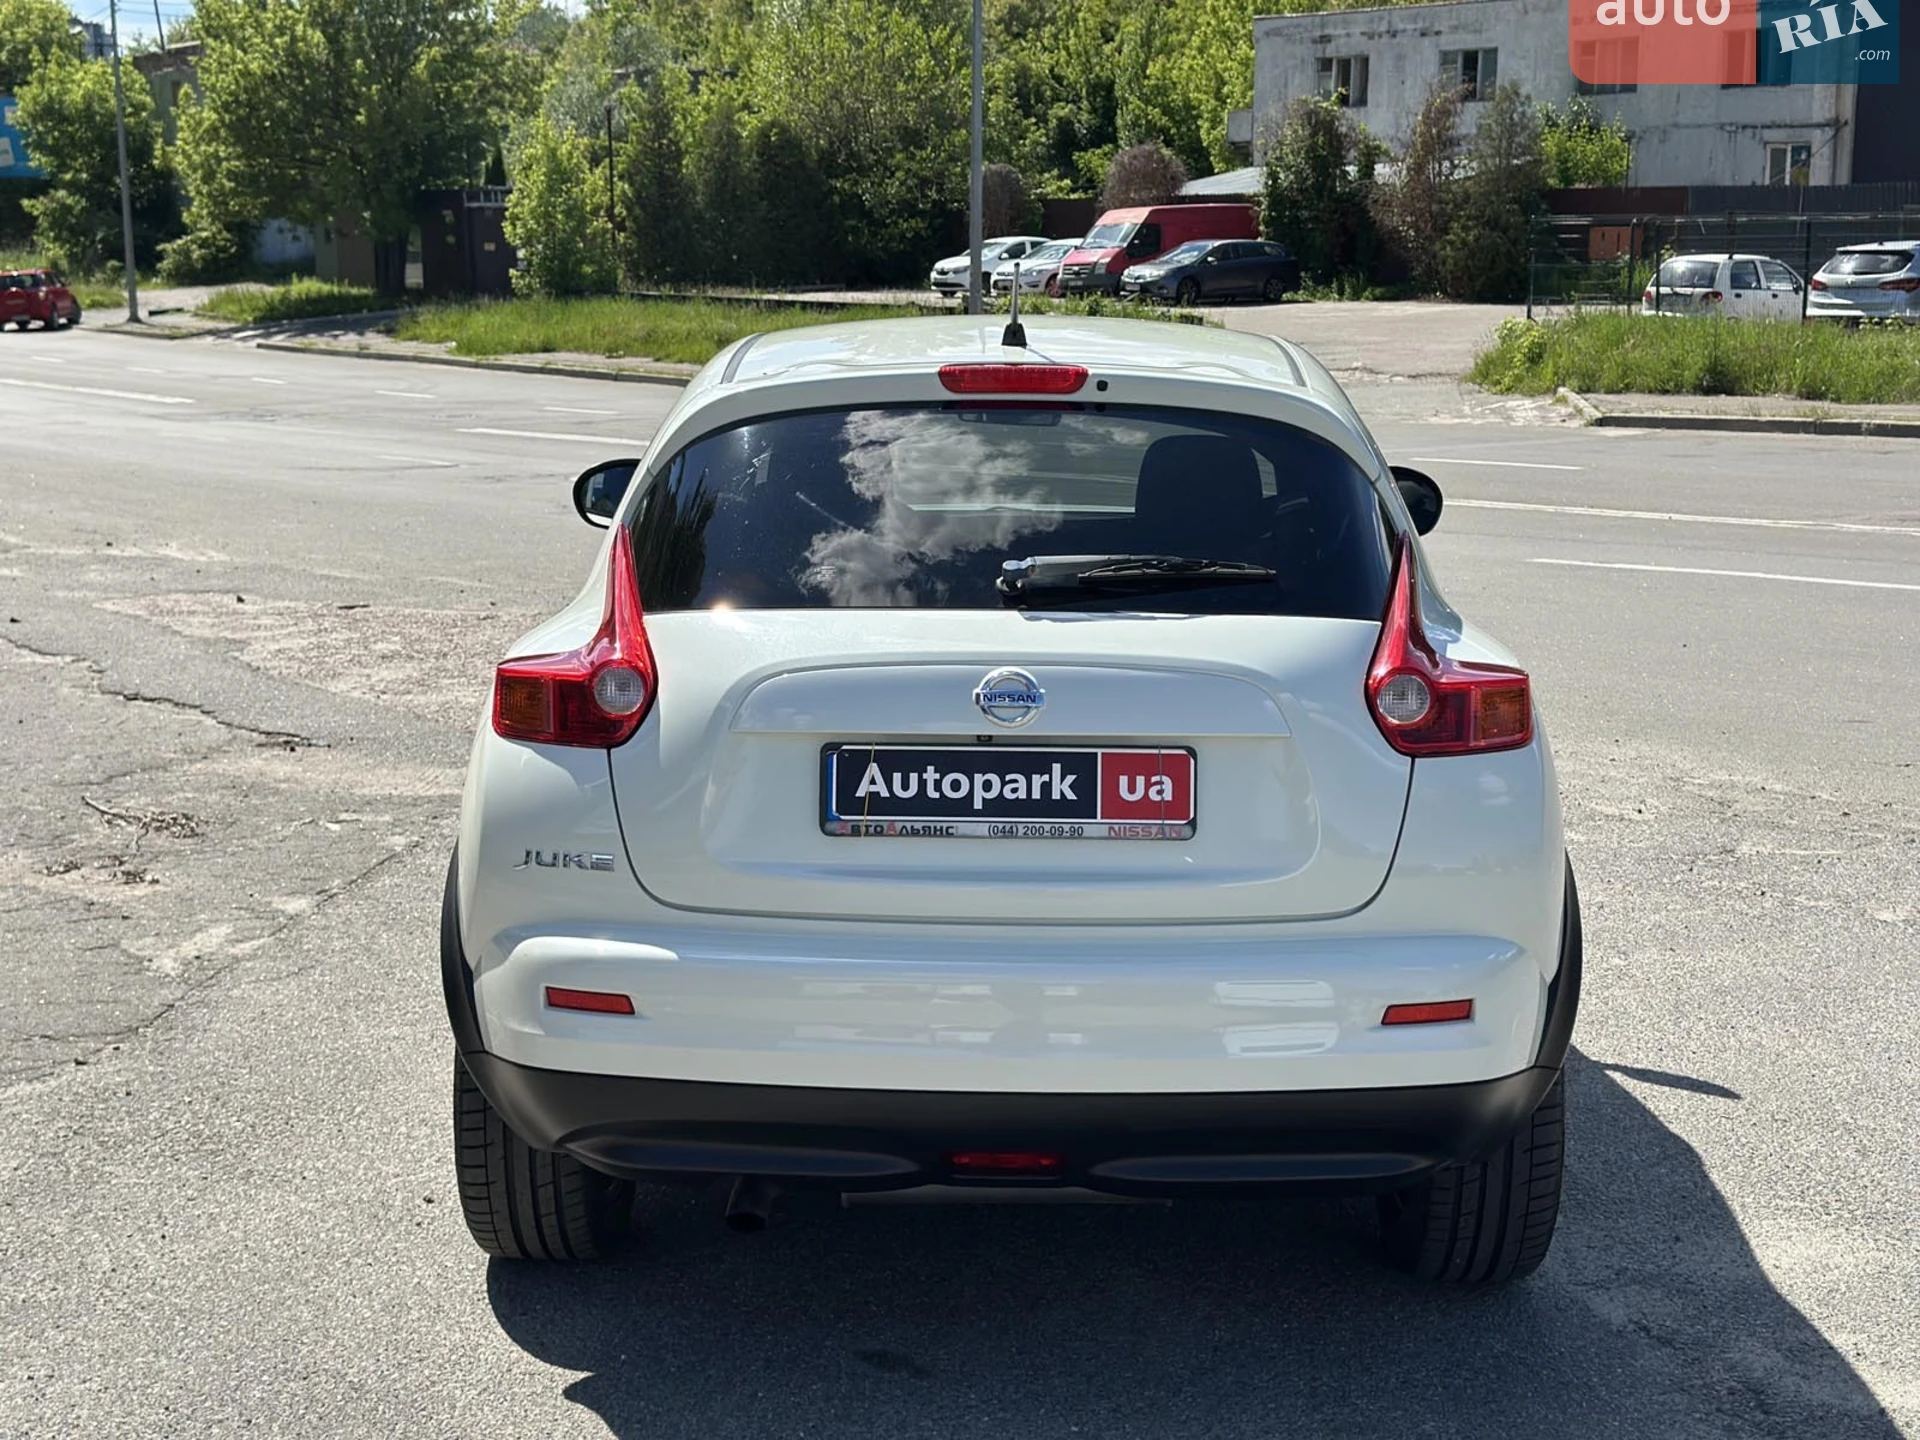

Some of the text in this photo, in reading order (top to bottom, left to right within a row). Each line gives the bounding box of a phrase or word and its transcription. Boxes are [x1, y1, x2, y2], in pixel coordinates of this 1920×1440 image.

[983, 694, 1037, 703] NISSAN
[855, 762, 1078, 809] Autopark
[1118, 774, 1173, 801] ua
[987, 825, 1084, 837] (044) 200-09-90
[1107, 825, 1183, 838] NISSAN
[512, 849, 615, 872] JUKE
